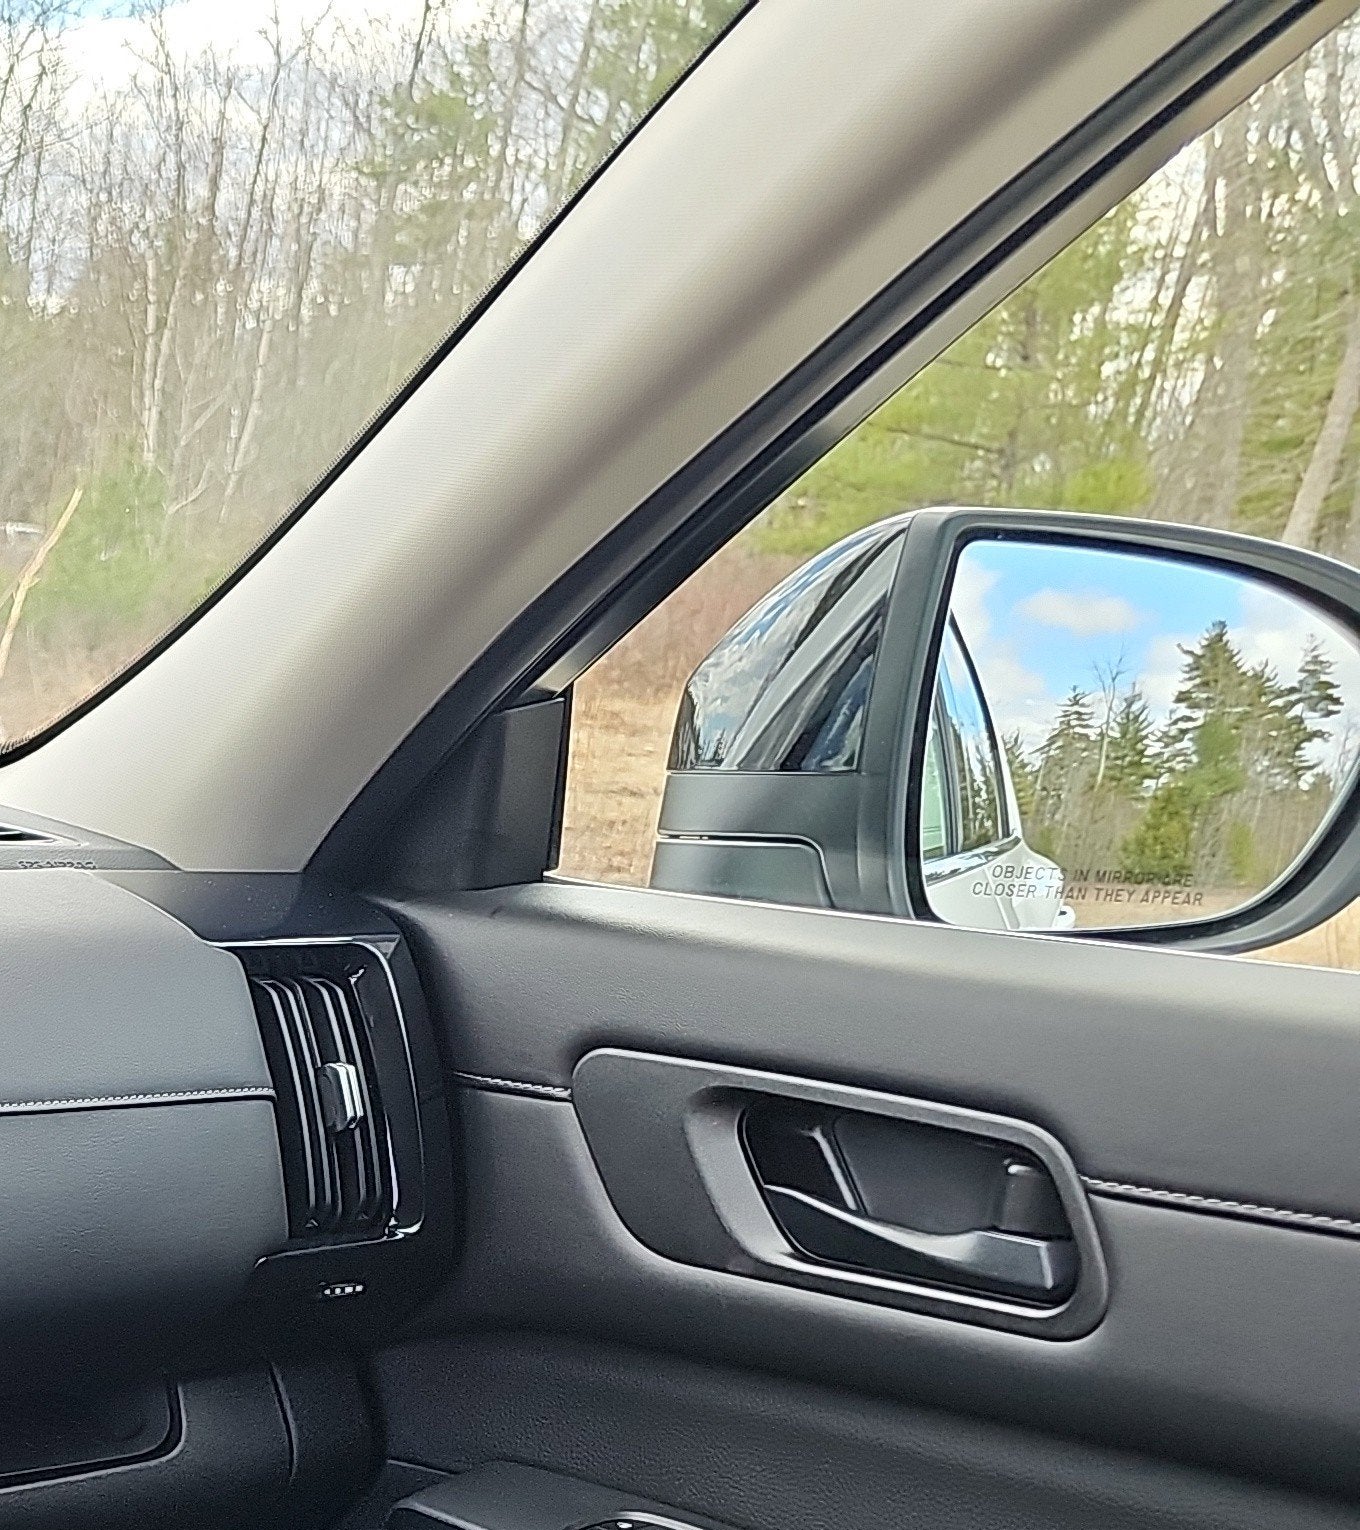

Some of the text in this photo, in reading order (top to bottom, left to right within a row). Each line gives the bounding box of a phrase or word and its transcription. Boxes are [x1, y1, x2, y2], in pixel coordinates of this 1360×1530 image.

[992, 865, 1193, 887] OBJECTS IN MIRROR ARE
[973, 882, 1203, 906] CLOSER THAN THEY APPEAR
